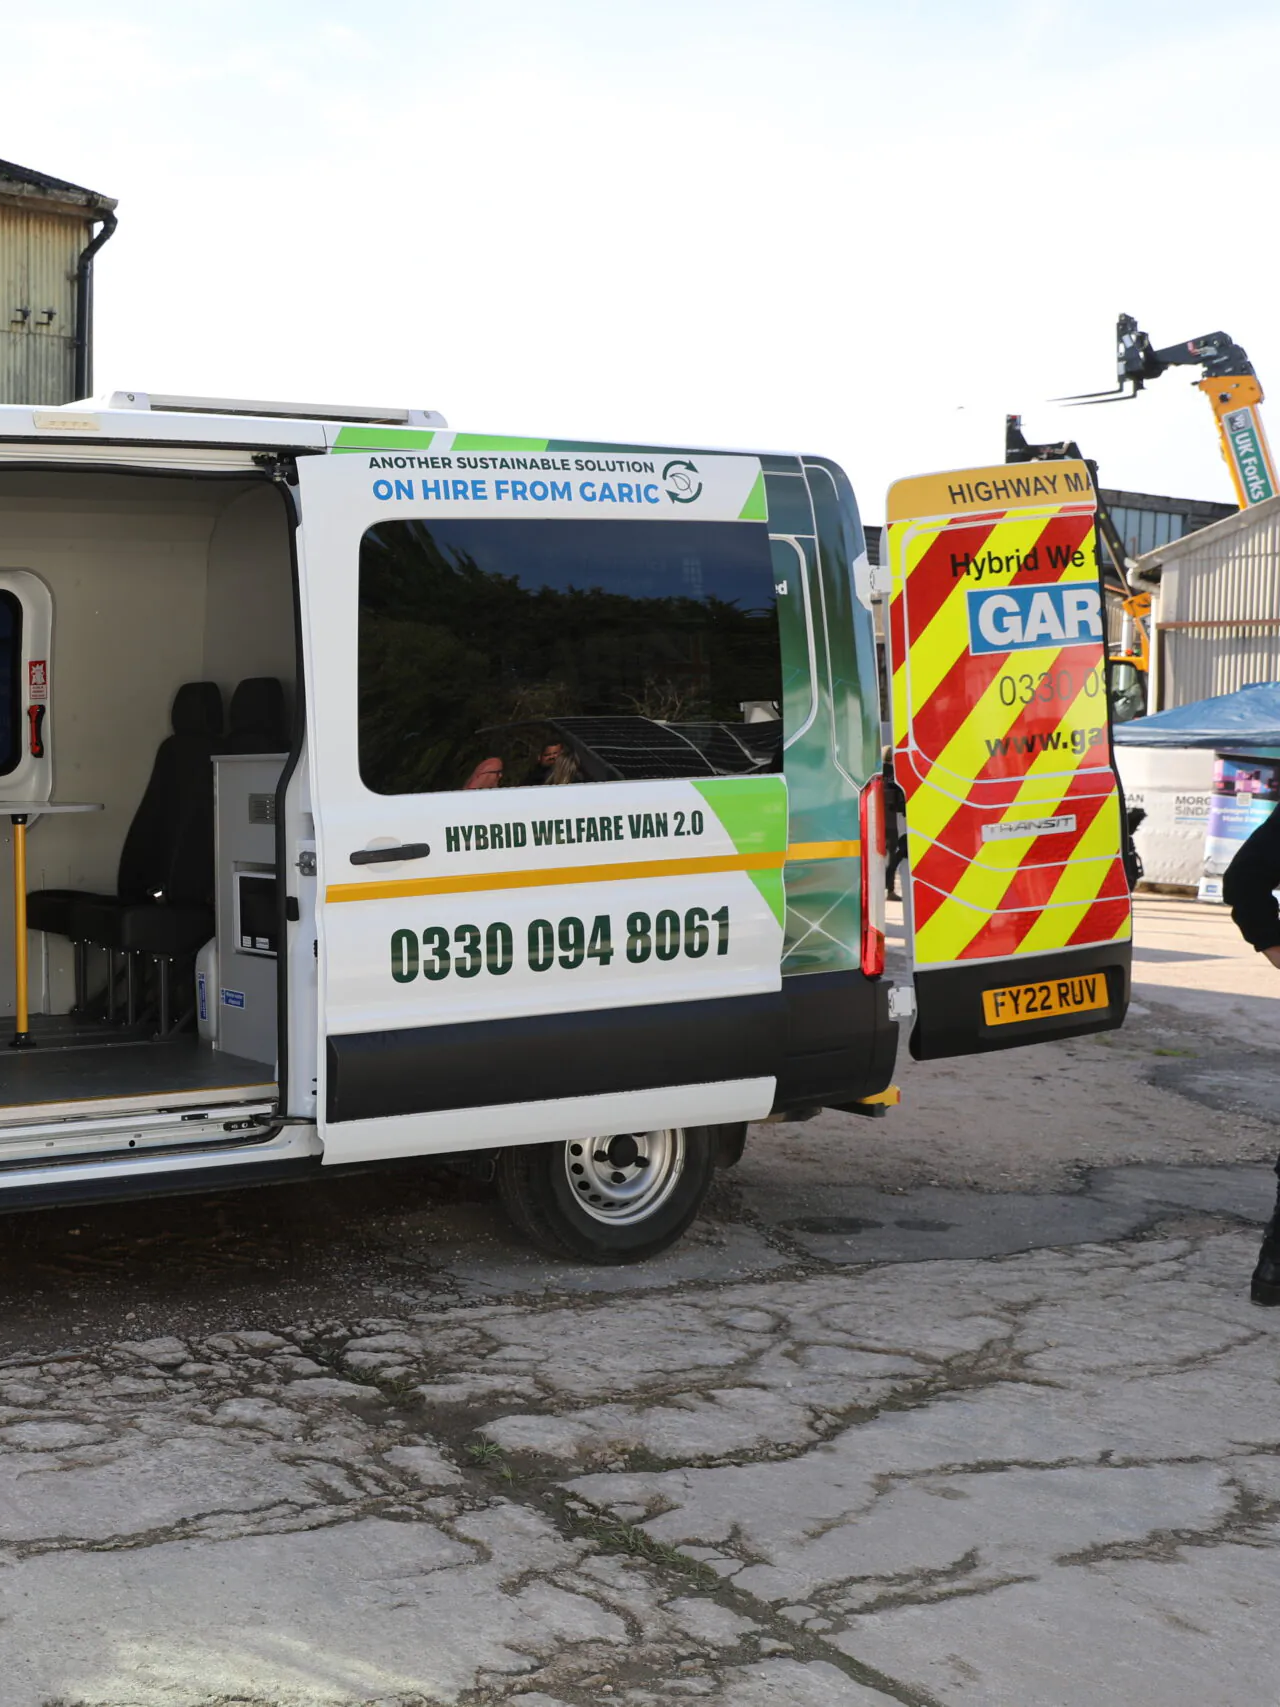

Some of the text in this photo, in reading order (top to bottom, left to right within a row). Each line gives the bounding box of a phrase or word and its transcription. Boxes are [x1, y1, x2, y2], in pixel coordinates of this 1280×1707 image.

[369, 457, 655, 473] ANOTHER SUSTAINABLE SOLUTION
[1235, 432, 1266, 501] UK Forks
[372, 479, 660, 504] ON HIRE FROM GARIC
[948, 474, 1059, 505] HIGHWAY
[950, 547, 1039, 581] Hybrid
[999, 670, 1073, 706] 0330
[445, 810, 704, 852] HYBRID WELFARE VAN 2.0
[986, 817, 1074, 834] TRANSIT
[390, 905, 730, 983] 0330 094 8061
[992, 977, 1097, 1018] FY22 RUV
